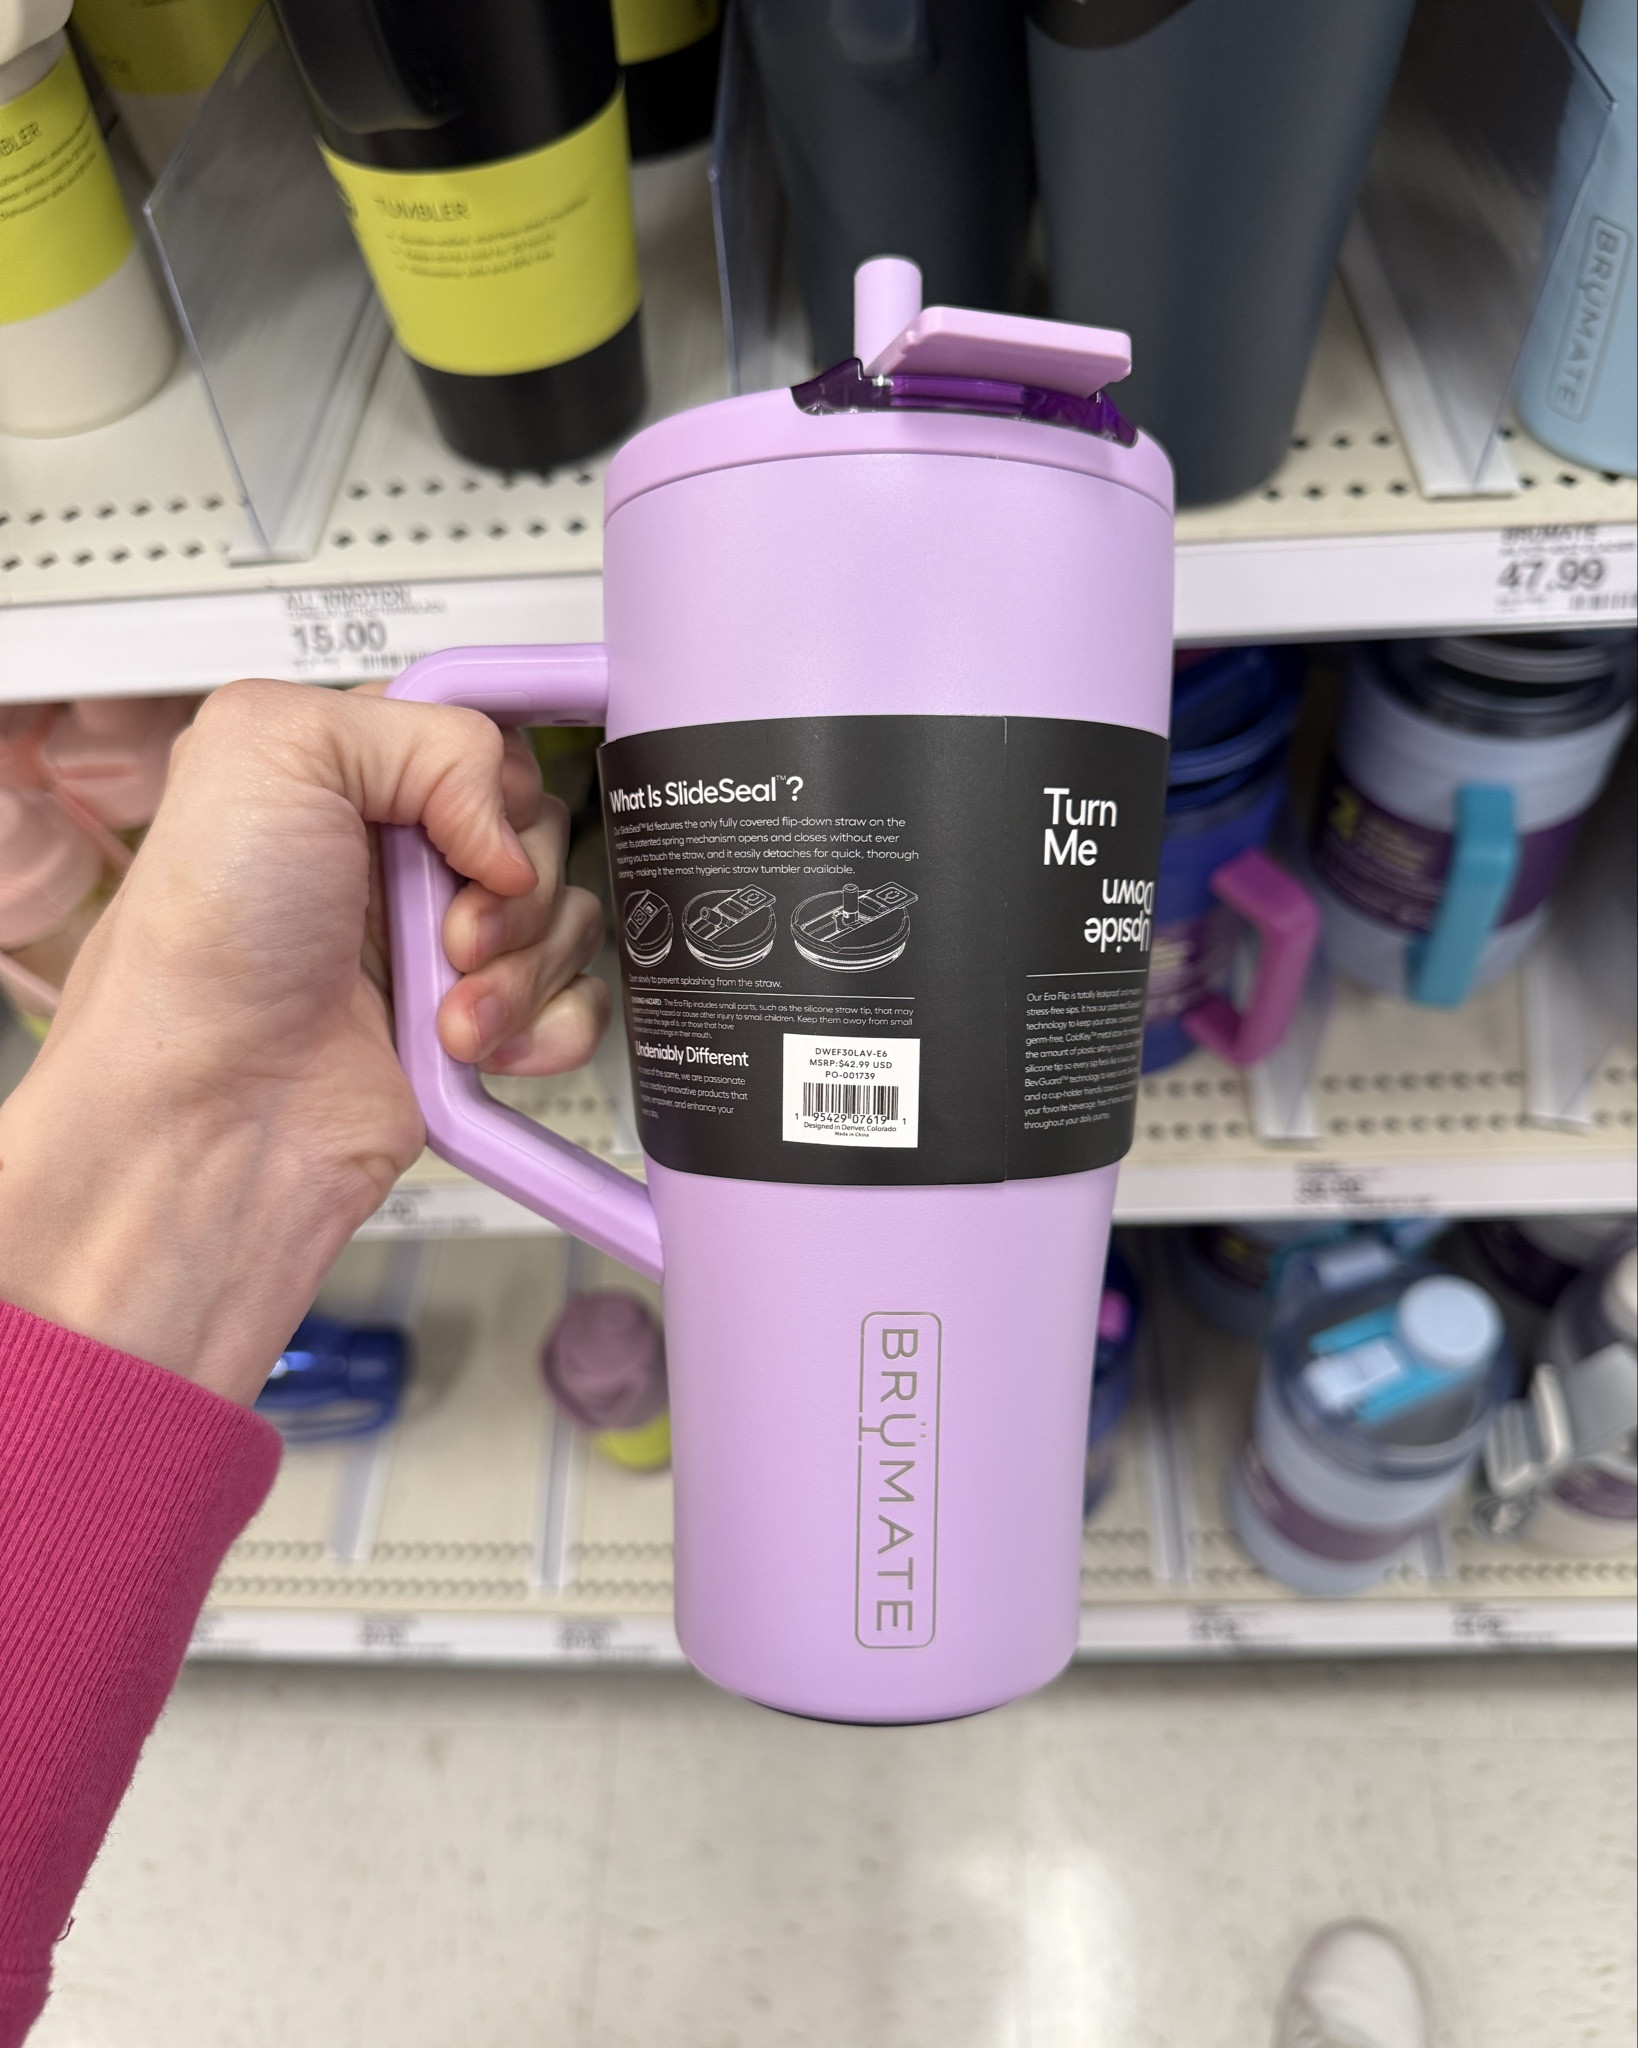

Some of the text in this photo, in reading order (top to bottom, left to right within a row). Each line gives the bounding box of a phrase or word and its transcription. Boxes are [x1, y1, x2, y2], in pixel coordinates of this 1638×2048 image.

[1497, 558, 1605, 592] 47.99
[291, 620, 388, 655] 15.00
[609, 787, 646, 814] What
[647, 784, 662, 808] Is
[1043, 787, 1118, 827] Turn
[646, 822, 654, 832] lid
[654, 820, 684, 831] features
[684, 820, 699, 829] the
[699, 819, 718, 830] only
[719, 818, 738, 829] fully
[740, 816, 780, 827] covered
[782, 815, 833, 828] flip-down
[834, 817, 867, 826] straw
[869, 818, 884, 827] on
[886, 817, 906, 827] the
[662, 836, 684, 847] spring
[685, 834, 736, 844] mechanism
[738, 834, 768, 844] opens
[770, 832, 791, 842] and
[794, 832, 827, 842] closes
[829, 833, 872, 842] without
[875, 834, 900, 843] ever
[1043, 828, 1098, 866] Me
[649, 852, 668, 861] touch
[668, 851, 681, 860] the
[682, 850, 706, 860] straw,
[707, 849, 725, 859] and
[726, 849, 732, 858] it
[734, 849, 761, 860] easily
[763, 848, 811, 858] detaches
[813, 847, 829, 858] for
[831, 848, 864, 860] quick,
[866, 849, 919, 862] thorough
[657, 864, 855, 877] it the most hygienic straw tumbler available.
[1102, 878, 1155, 915] Down
[1084, 910, 1150, 953] Upside
[657, 976, 680, 986] prevent
[680, 976, 715, 988] splashing
[716, 977, 737, 986] from
[738, 978, 753, 987] the
[754, 979, 782, 988] straw.
[1026, 990, 1095, 1002] Our Era Flip is totally
[664, 998, 673, 1007] The
[693, 1001, 717, 1009] includes
[718, 1001, 736, 1010] small
[737, 1003, 757, 1011] parts,
[759, 1003, 777, 1011] such
[789, 1004, 802, 1012] the
[803, 1004, 834, 1014] silicone
[835, 1006, 858, 1014] straw
[860, 1006, 873, 1015] tip,
[874, 1007, 893, 1015] that
[894, 1008, 914, 1017] may
[1026, 1005, 1065, 1017] stress-free
[1086, 1004, 1097, 1012] has
[700, 1010, 716, 1019] other
[717, 1011, 735, 1021] injury
[743, 1013, 763, 1021] small
[764, 1013, 796, 1022] children.
[797, 1015, 818, 1024] Keep
[819, 1015, 841, 1024] them
[842, 1017, 867, 1026] away
[868, 1017, 889, 1025] from
[890, 1018, 913, 1026] small
[1026, 1020, 1067, 1030] technology
[1076, 1019, 1091, 1028] keep
[1092, 1019, 1103, 1027] your
[687, 1020, 704, 1029] those
[704, 1021, 717, 1029] that
[718, 1022, 735, 1030] have
[691, 1031, 713, 1039] mouth.
[1025, 1034, 1064, 1046] germ-free.
[635, 1040, 749, 1066] Undeniably Different
[815, 1047, 888, 1058] DWEF30LAV-E6
[1025, 1046, 1096, 1059] the amount of plastic
[809, 1059, 893, 1069] MSRP:$42.99 USD
[1025, 1064, 1053, 1073] silicone
[1053, 1062, 1063, 1072] tip
[1072, 1061, 1089, 1069] every
[681, 1073, 690, 1081] we
[691, 1074, 702, 1082] are
[704, 1074, 746, 1085] passionate
[825, 1070, 876, 1080] PO-001739
[667, 1084, 748, 1100] innovative products that
[1024, 1092, 1041, 1101] and
[1048, 1089, 1083, 1100] cup-holder
[674, 1100, 735, 1114] and enhance your
[1024, 1107, 1041, 1117] your
[1042, 1104, 1068, 1114] favorite
[813, 1112, 847, 1123] 95429
[852, 1114, 887, 1125] 07619
[1024, 1118, 1065, 1129] throughout
[1065, 1117, 1079, 1126] your
[804, 1121, 833, 1130] Designed
[841, 1124, 866, 1132] Denver,
